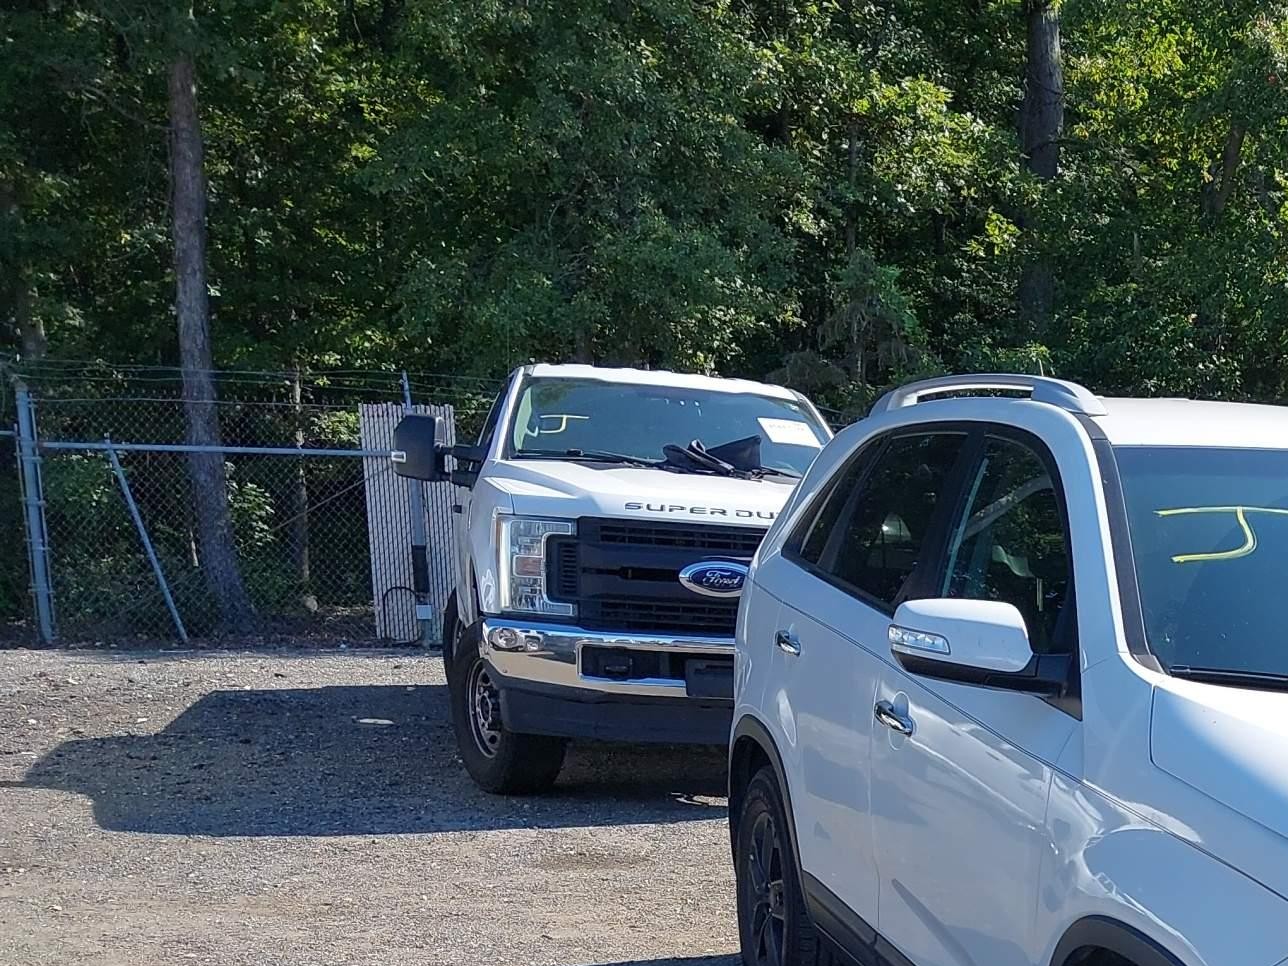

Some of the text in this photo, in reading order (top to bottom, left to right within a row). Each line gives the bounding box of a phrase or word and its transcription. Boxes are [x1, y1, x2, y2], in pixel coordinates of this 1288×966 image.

[624, 502, 778, 520] SUPER DU
[702, 569, 741, 586] Ford
